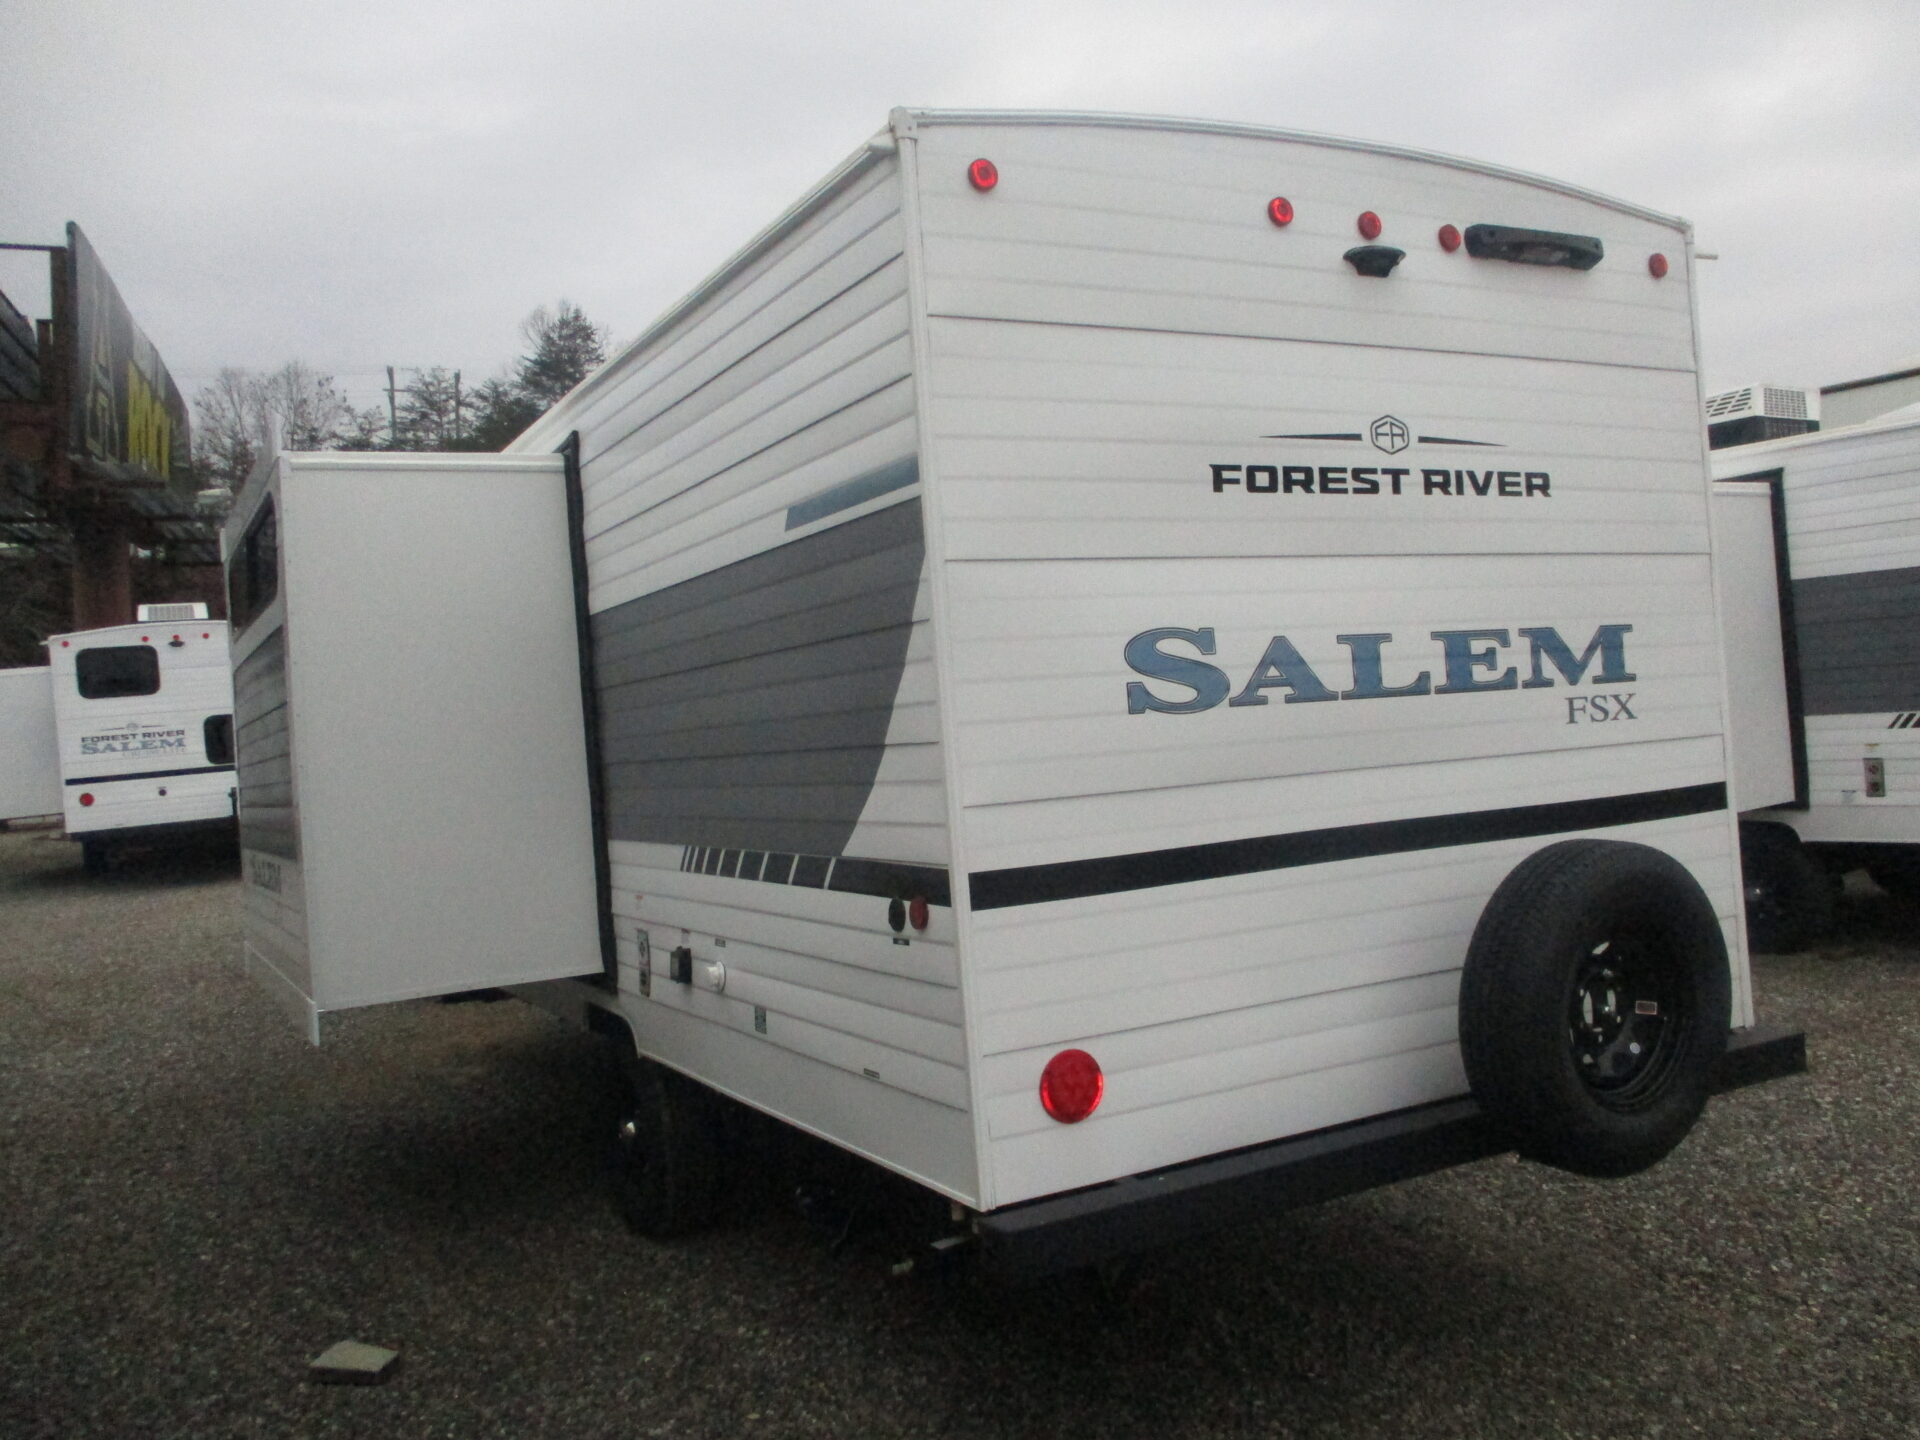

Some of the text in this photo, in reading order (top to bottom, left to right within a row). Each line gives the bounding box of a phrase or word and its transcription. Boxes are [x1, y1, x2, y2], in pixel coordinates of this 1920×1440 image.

[1209, 464, 1552, 497] FOREST RIVER
[1124, 624, 1637, 715] SALEM
[1565, 693, 1638, 724] FSX
[81, 729, 185, 743] FOREST RIVER
[81, 738, 186, 755] SALEM
